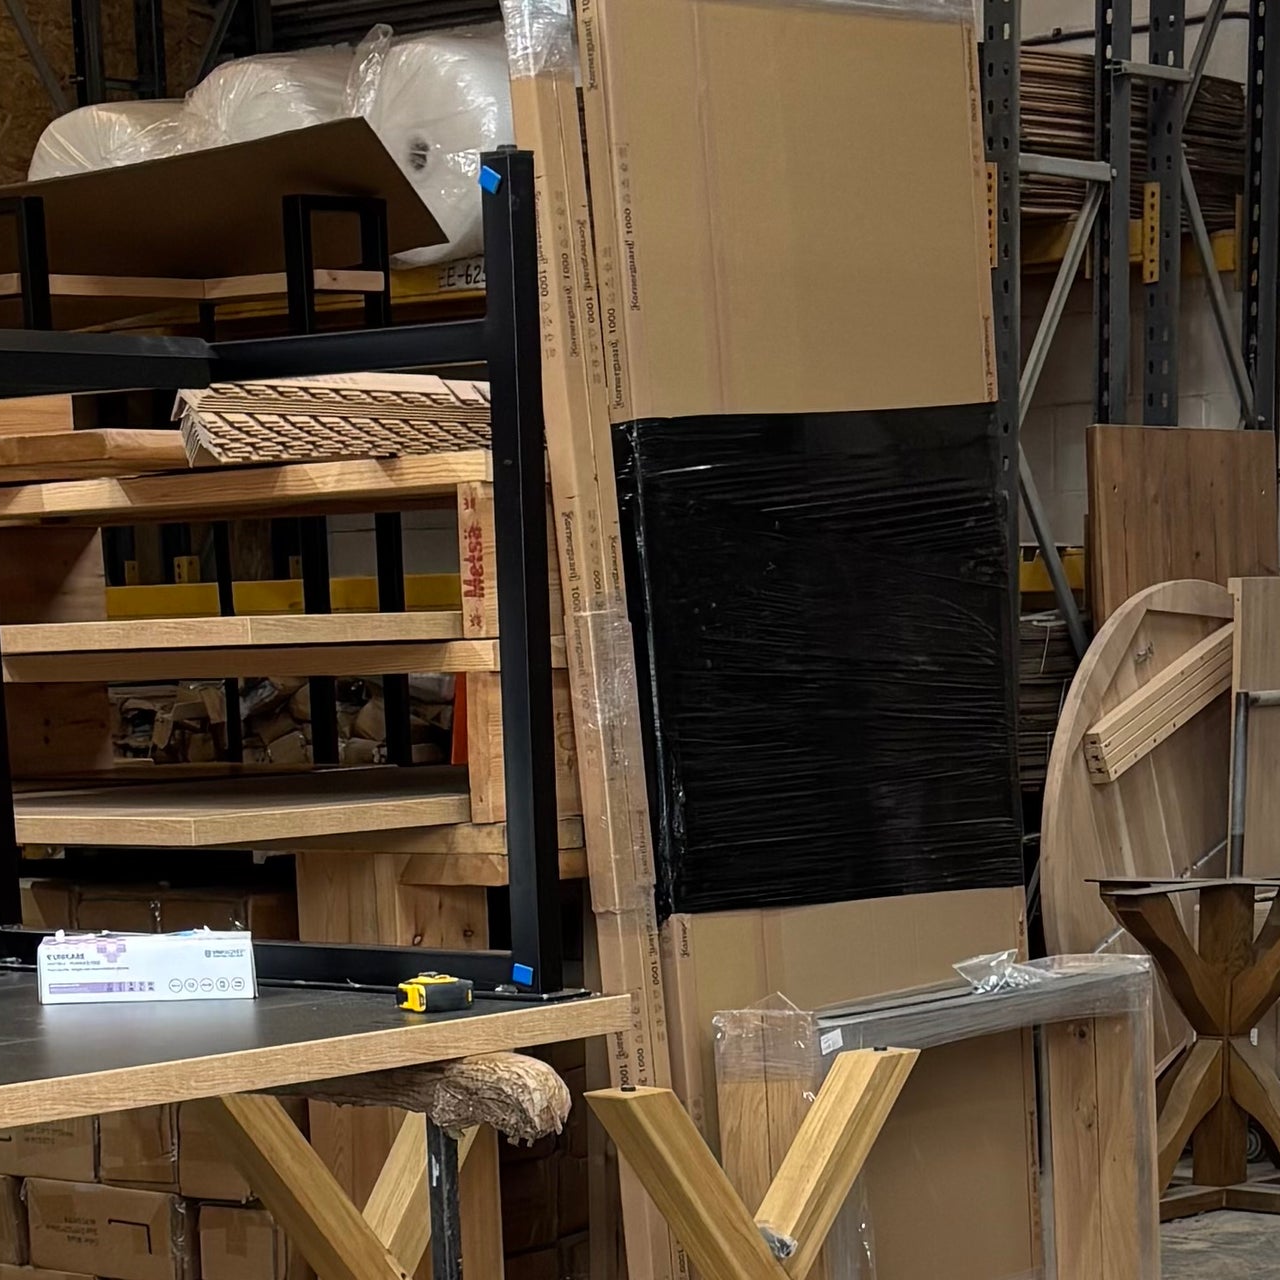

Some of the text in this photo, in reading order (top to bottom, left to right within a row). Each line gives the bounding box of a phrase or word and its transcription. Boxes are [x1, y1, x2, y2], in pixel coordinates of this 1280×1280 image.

[561, 253, 570, 279] 1000
[624, 207, 640, 311] Kornerguard 1000
[539, 270, 549, 297] 1000
[586, 297, 596, 324] 1000
[607, 308, 616, 333] 1000
[593, 570, 602, 595] 1000
[650, 961, 660, 986] 1000
[636, 1047, 646, 1073] 1000
